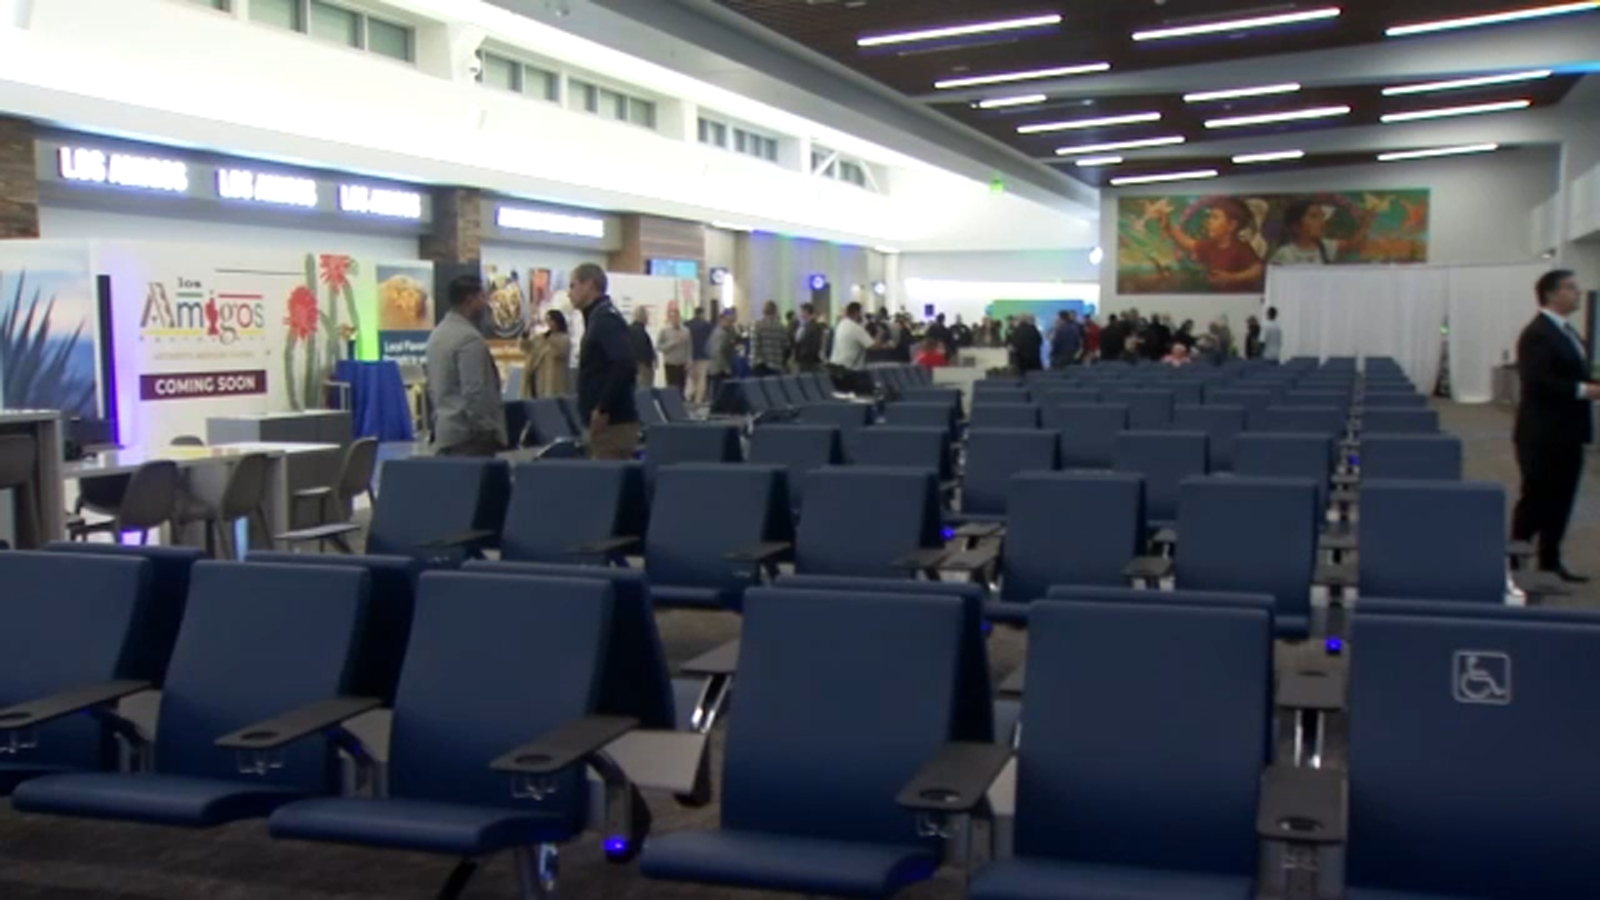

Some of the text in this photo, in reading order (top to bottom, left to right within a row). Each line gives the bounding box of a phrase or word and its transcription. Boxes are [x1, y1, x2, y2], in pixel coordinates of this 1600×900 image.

[58, 147, 106, 181] LOS
[215, 169, 253, 200] LOS
[177, 276, 202, 289] los
[140, 281, 265, 345] Amigos
[154, 374, 256, 395] COMING SOON
